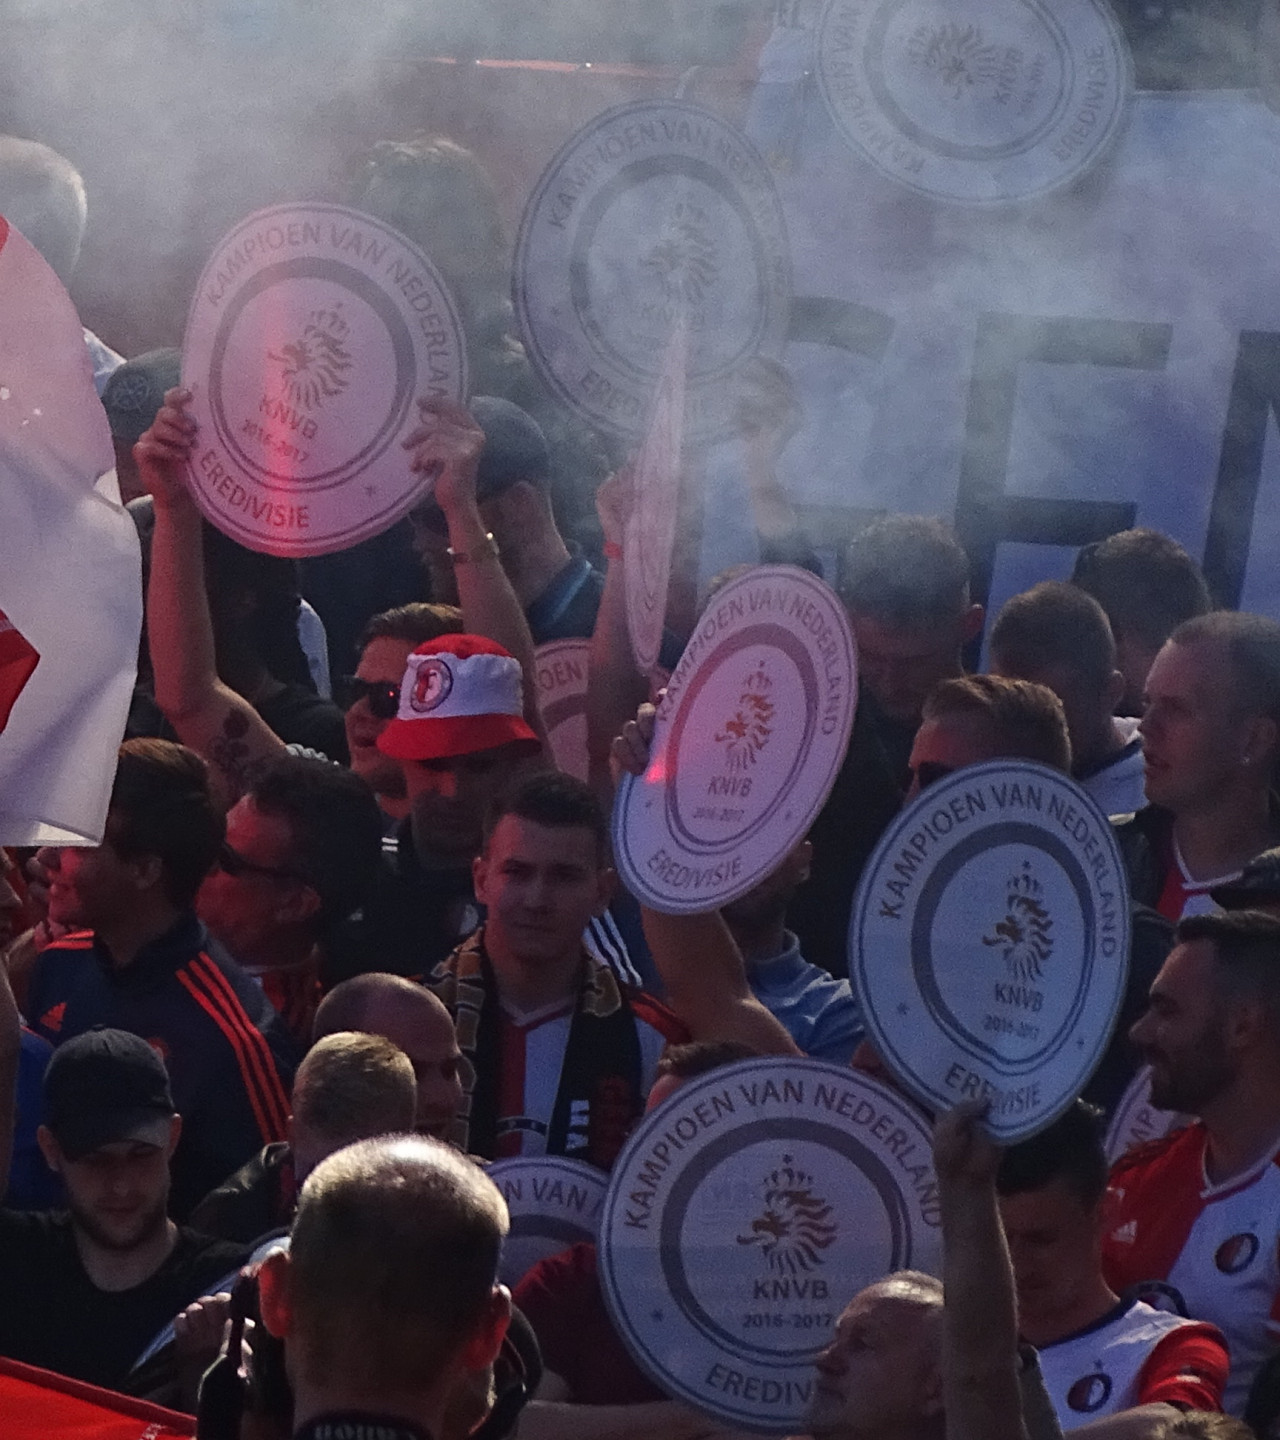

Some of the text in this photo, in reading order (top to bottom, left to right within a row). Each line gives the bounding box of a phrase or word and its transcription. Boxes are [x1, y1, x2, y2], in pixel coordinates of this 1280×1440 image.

[205, 222, 322, 308] KAMPIOEN
[329, 225, 390, 266] VAN
[200, 449, 311, 529] EREDIVISIE
[658, 588, 839, 737] KAMPIOEN VAN NEDERLAND
[707, 775, 754, 799] KNVB
[646, 847, 743, 889] EREDIVISIE
[878, 782, 1117, 959] KAMPIOEN VAN NEDERLAND
[994, 982, 1045, 1013] KNVB
[624, 1079, 941, 1232] KAMPIOEN VAN NEDERLAND
[532, 1176, 589, 1212] VAN
[752, 1278, 829, 1301] KNVB
[742, 1312, 832, 1330] 2016-2017
[704, 1363, 812, 1407] EREDIV
